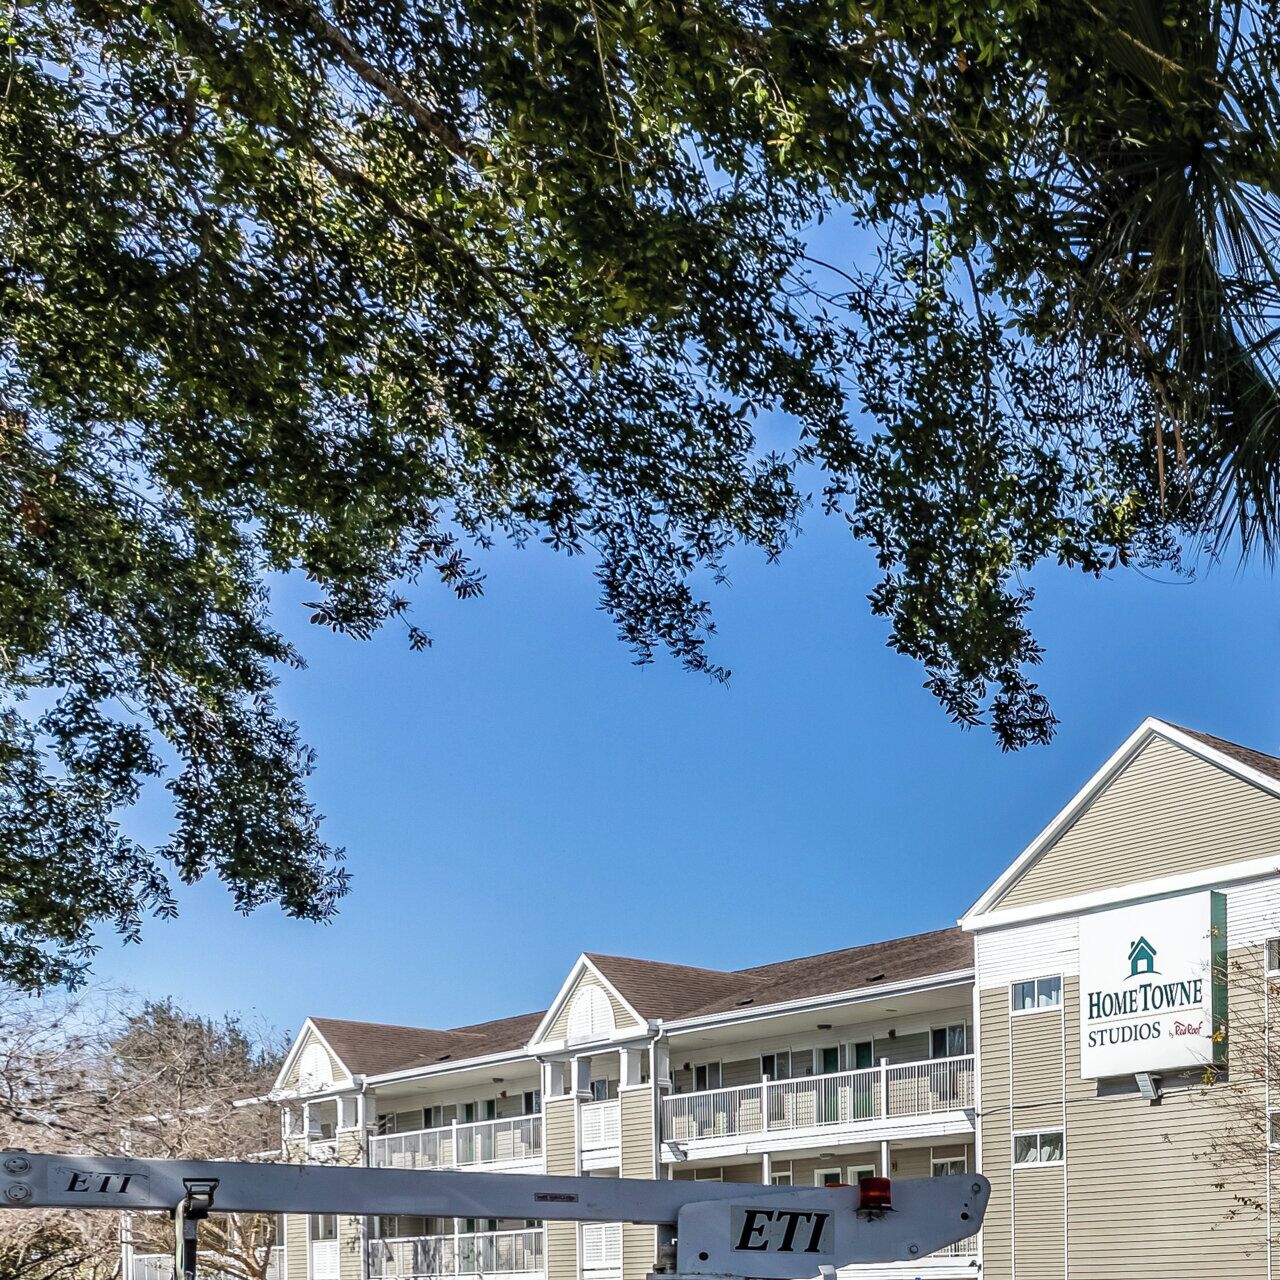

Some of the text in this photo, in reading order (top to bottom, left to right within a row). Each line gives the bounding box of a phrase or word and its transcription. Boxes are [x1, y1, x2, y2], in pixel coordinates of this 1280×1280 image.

[1087, 1021, 1161, 1048] STUDIOS
[65, 1171, 133, 1194] ETI
[735, 1209, 830, 1252] ETI
